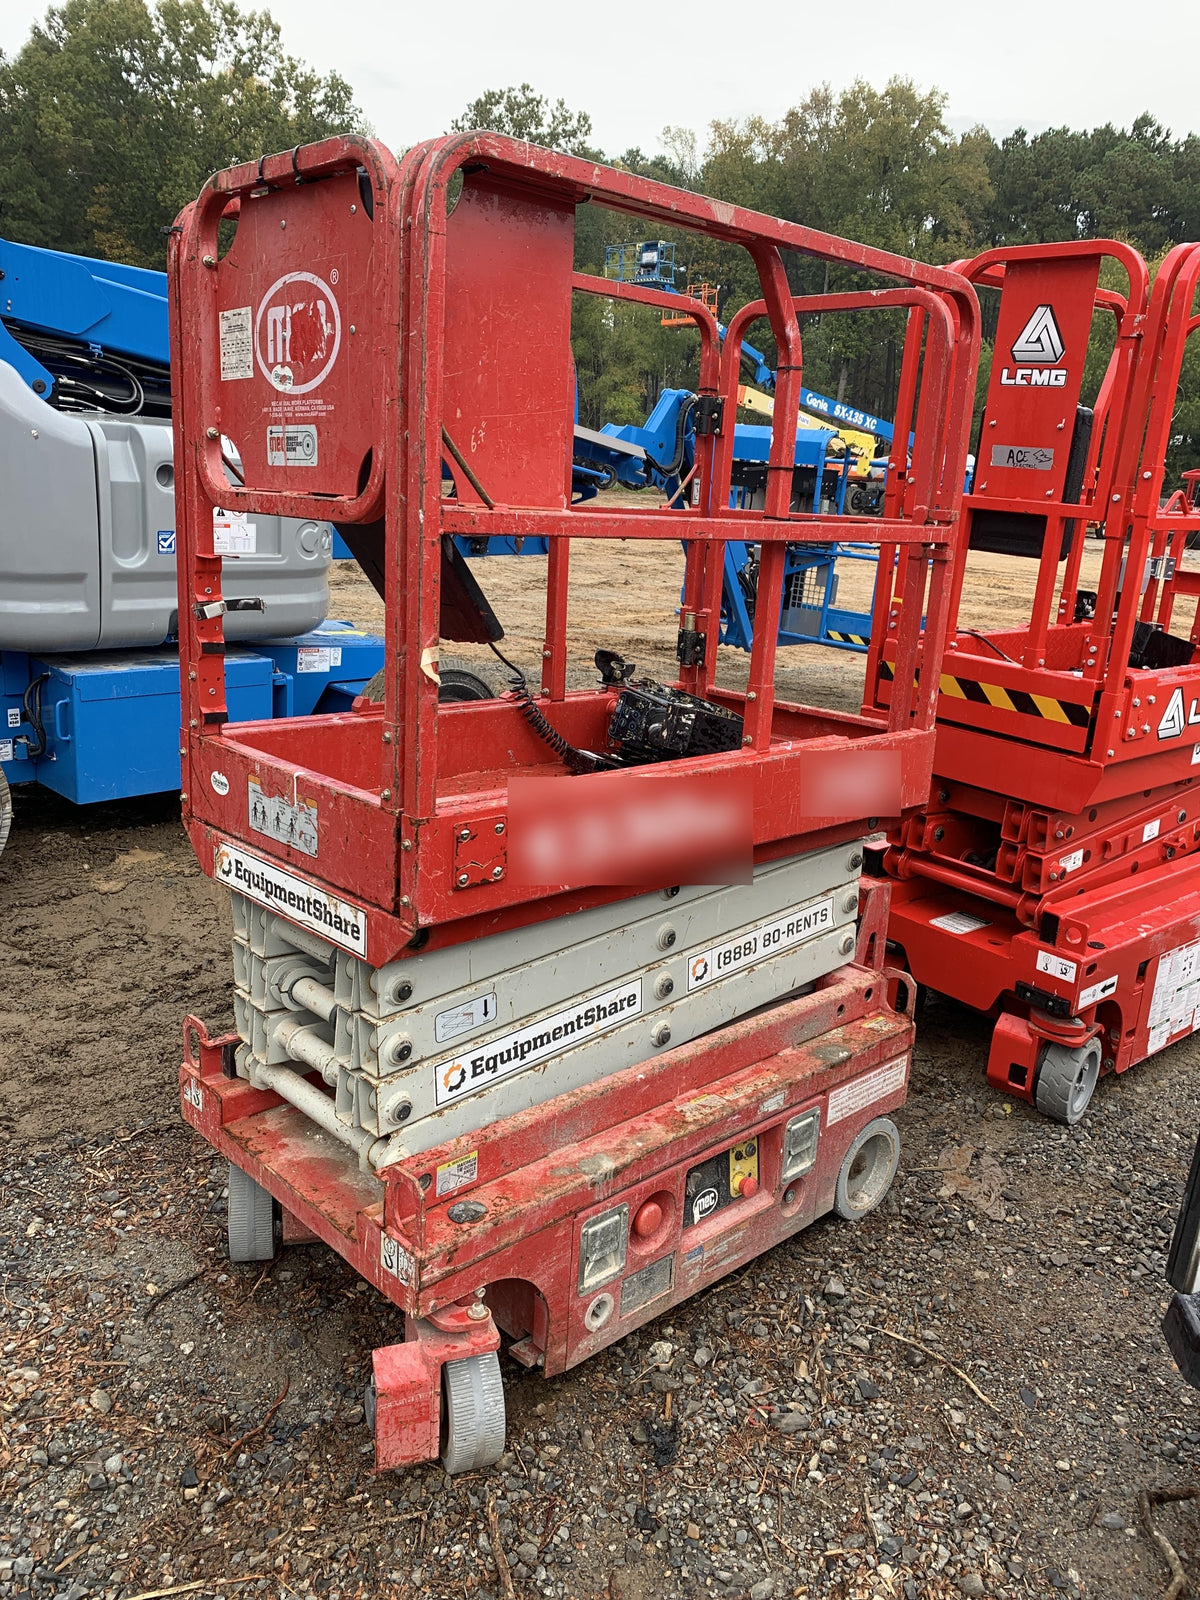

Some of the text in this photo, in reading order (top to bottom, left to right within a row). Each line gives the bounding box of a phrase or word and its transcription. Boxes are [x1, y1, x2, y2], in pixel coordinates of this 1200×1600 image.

[806, 393, 828, 412] Genie
[864, 415, 877, 430] XC
[1006, 449, 1031, 465] ACE
[234, 858, 361, 942] EquipmentShare
[717, 908, 828, 969] (888) 80-RENTS
[470, 993, 637, 1079] EquipmentShare
[697, 1192, 715, 1212] mec
